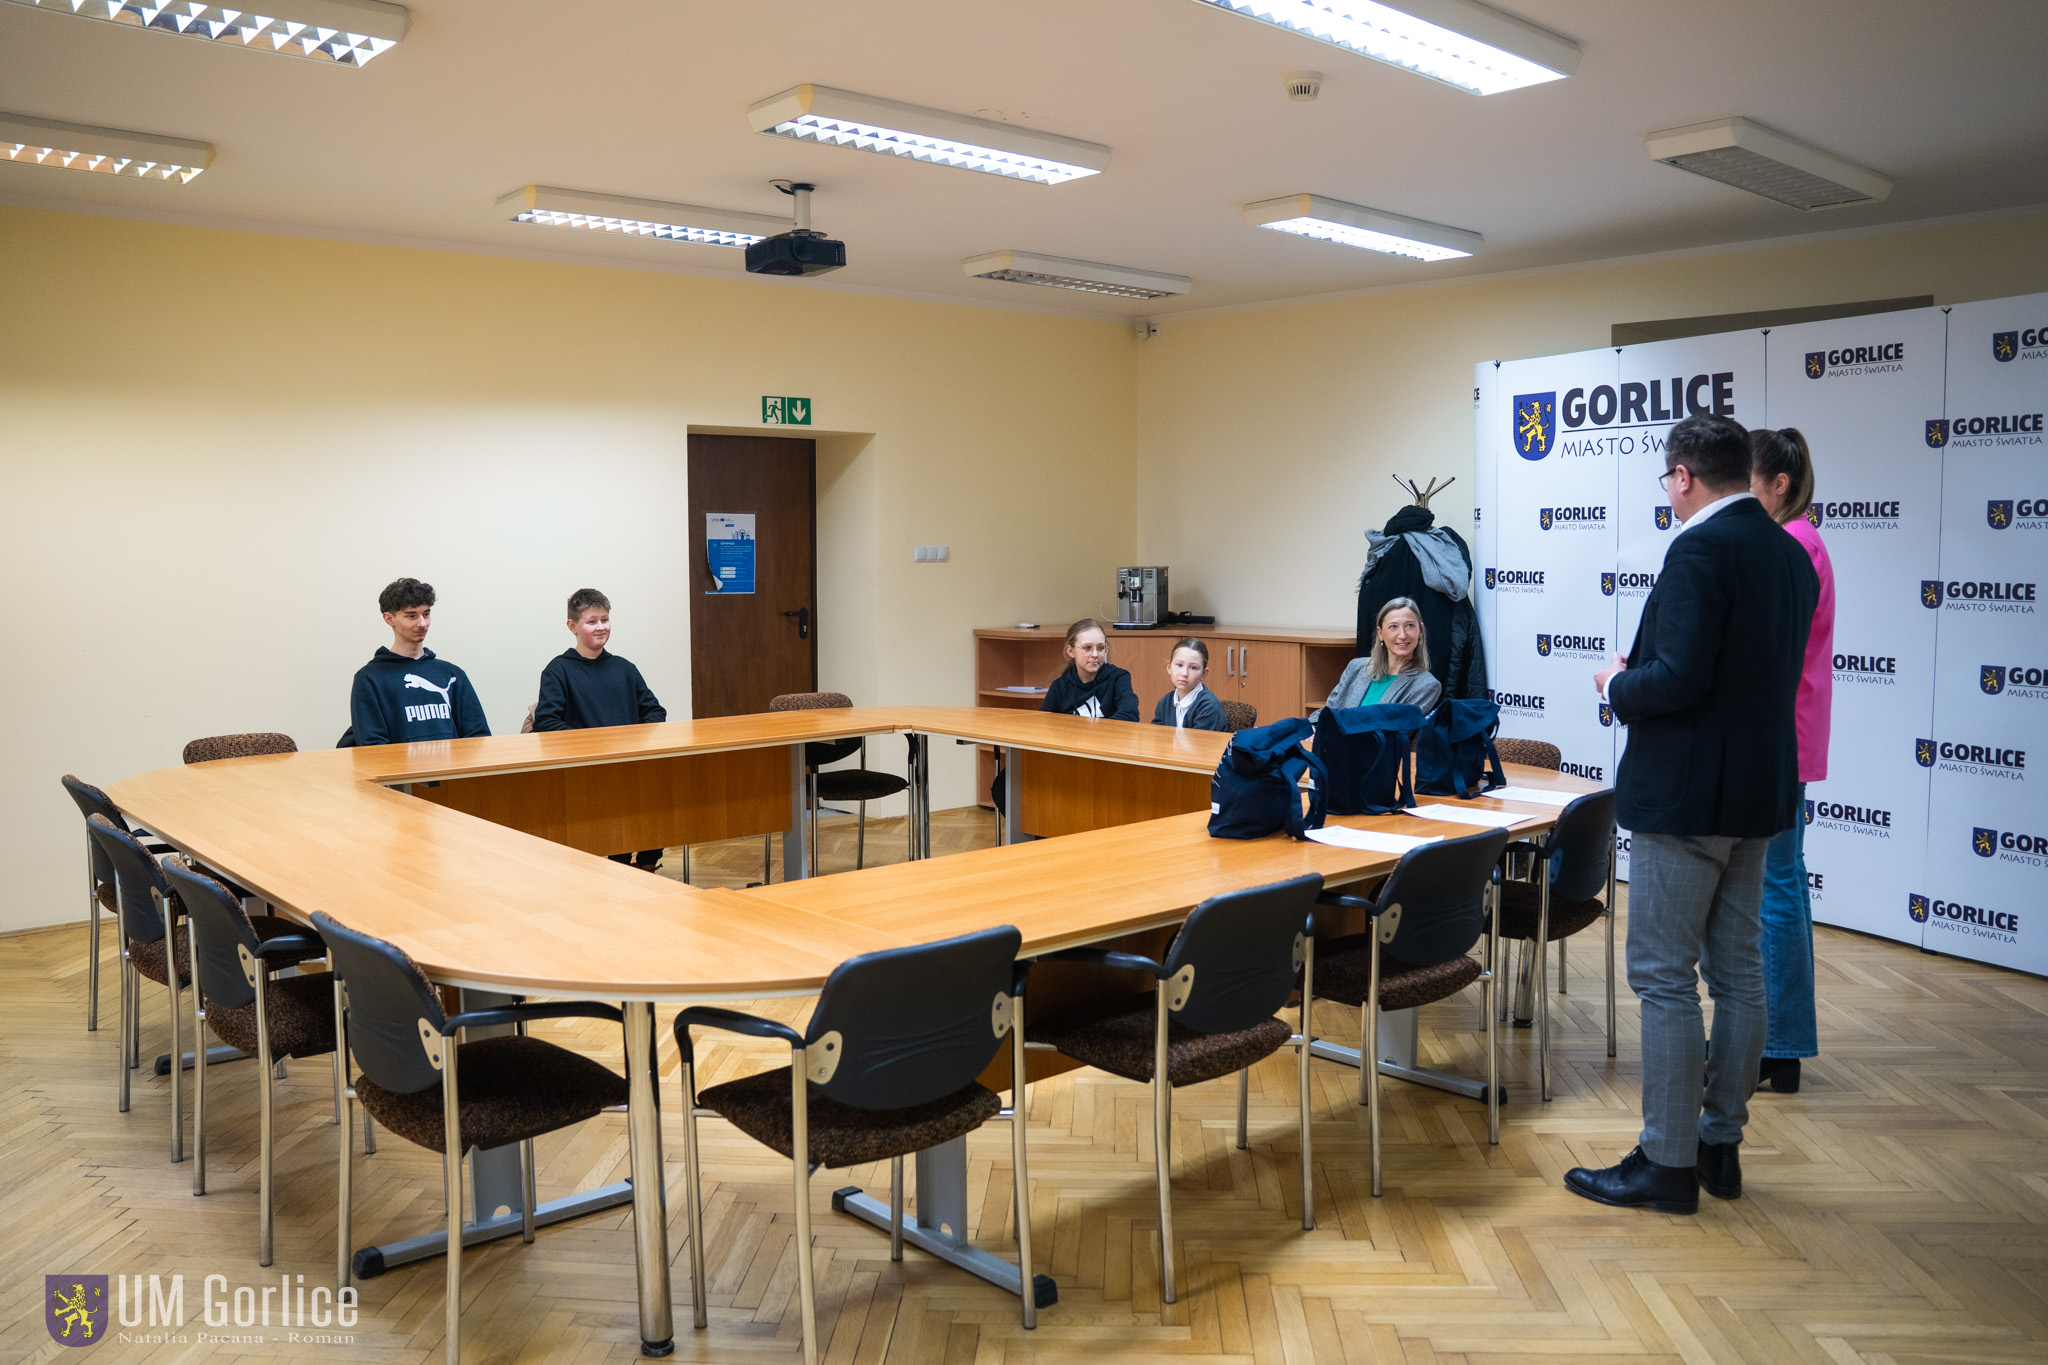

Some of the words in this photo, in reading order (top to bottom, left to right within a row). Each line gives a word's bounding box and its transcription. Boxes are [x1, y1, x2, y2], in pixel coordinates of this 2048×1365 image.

[1828, 343, 1903, 366] GORLICE
[2021, 349, 2048, 360] MIAS
[1828, 367, 1862, 378] MIASTO
[1865, 364, 1903, 375] ŚWIATŁA
[1562, 372, 1734, 428] GORLICE
[1953, 414, 2043, 435] GORLICE
[1561, 437, 1634, 458] MIASTO
[1952, 439, 1993, 448] MIASTO
[1996, 436, 2043, 446] ŚWIATŁA
[1555, 507, 1606, 520] GORLICE
[1826, 501, 1899, 518] GORLICE
[1554, 523, 1577, 531] MIASTO
[1579, 522, 1606, 530] ŚWIATŁA
[1825, 521, 1858, 530] MIASTO
[1861, 520, 1898, 530] ŚWIATŁA
[2016, 521, 2048, 530] MIAST
[1497, 571, 1544, 584] GORLICE
[1619, 573, 1658, 587] GORL
[1521, 586, 1544, 594] ŚWIATŁA
[1618, 590, 1645, 598] MIASTO
[1947, 582, 2036, 600] GORLICE
[1946, 603, 1986, 612] MIASTO
[1990, 603, 2034, 613] ŚWIATŁA
[1553, 635, 1605, 650] GORLICE
[1579, 652, 1605, 661] ŚWIATŁA
[1833, 654, 1895, 673] ORLICE
[1832, 674, 1854, 682] ASTO
[1857, 674, 1895, 685] ŚWIATŁA
[1496, 692, 1544, 709] GORLICE
[405, 704, 450, 722] PUMA
[1940, 742, 2025, 768] GORLICE
[1561, 762, 1602, 780] ORLICE
[1939, 763, 1977, 774] MIASTO
[1980, 767, 2024, 781] ŚWIATŁA
[1817, 801, 1891, 827] GORLICE
[1817, 820, 1850, 832] MIASTO
[1853, 824, 1890, 839] ŚWIATŁA
[2000, 852, 2041, 866] MIASTO
[1932, 900, 2018, 932] GORLICE
[1932, 920, 1969, 934] MIASTO
[1973, 927, 2016, 944] ŚWIATŁA
